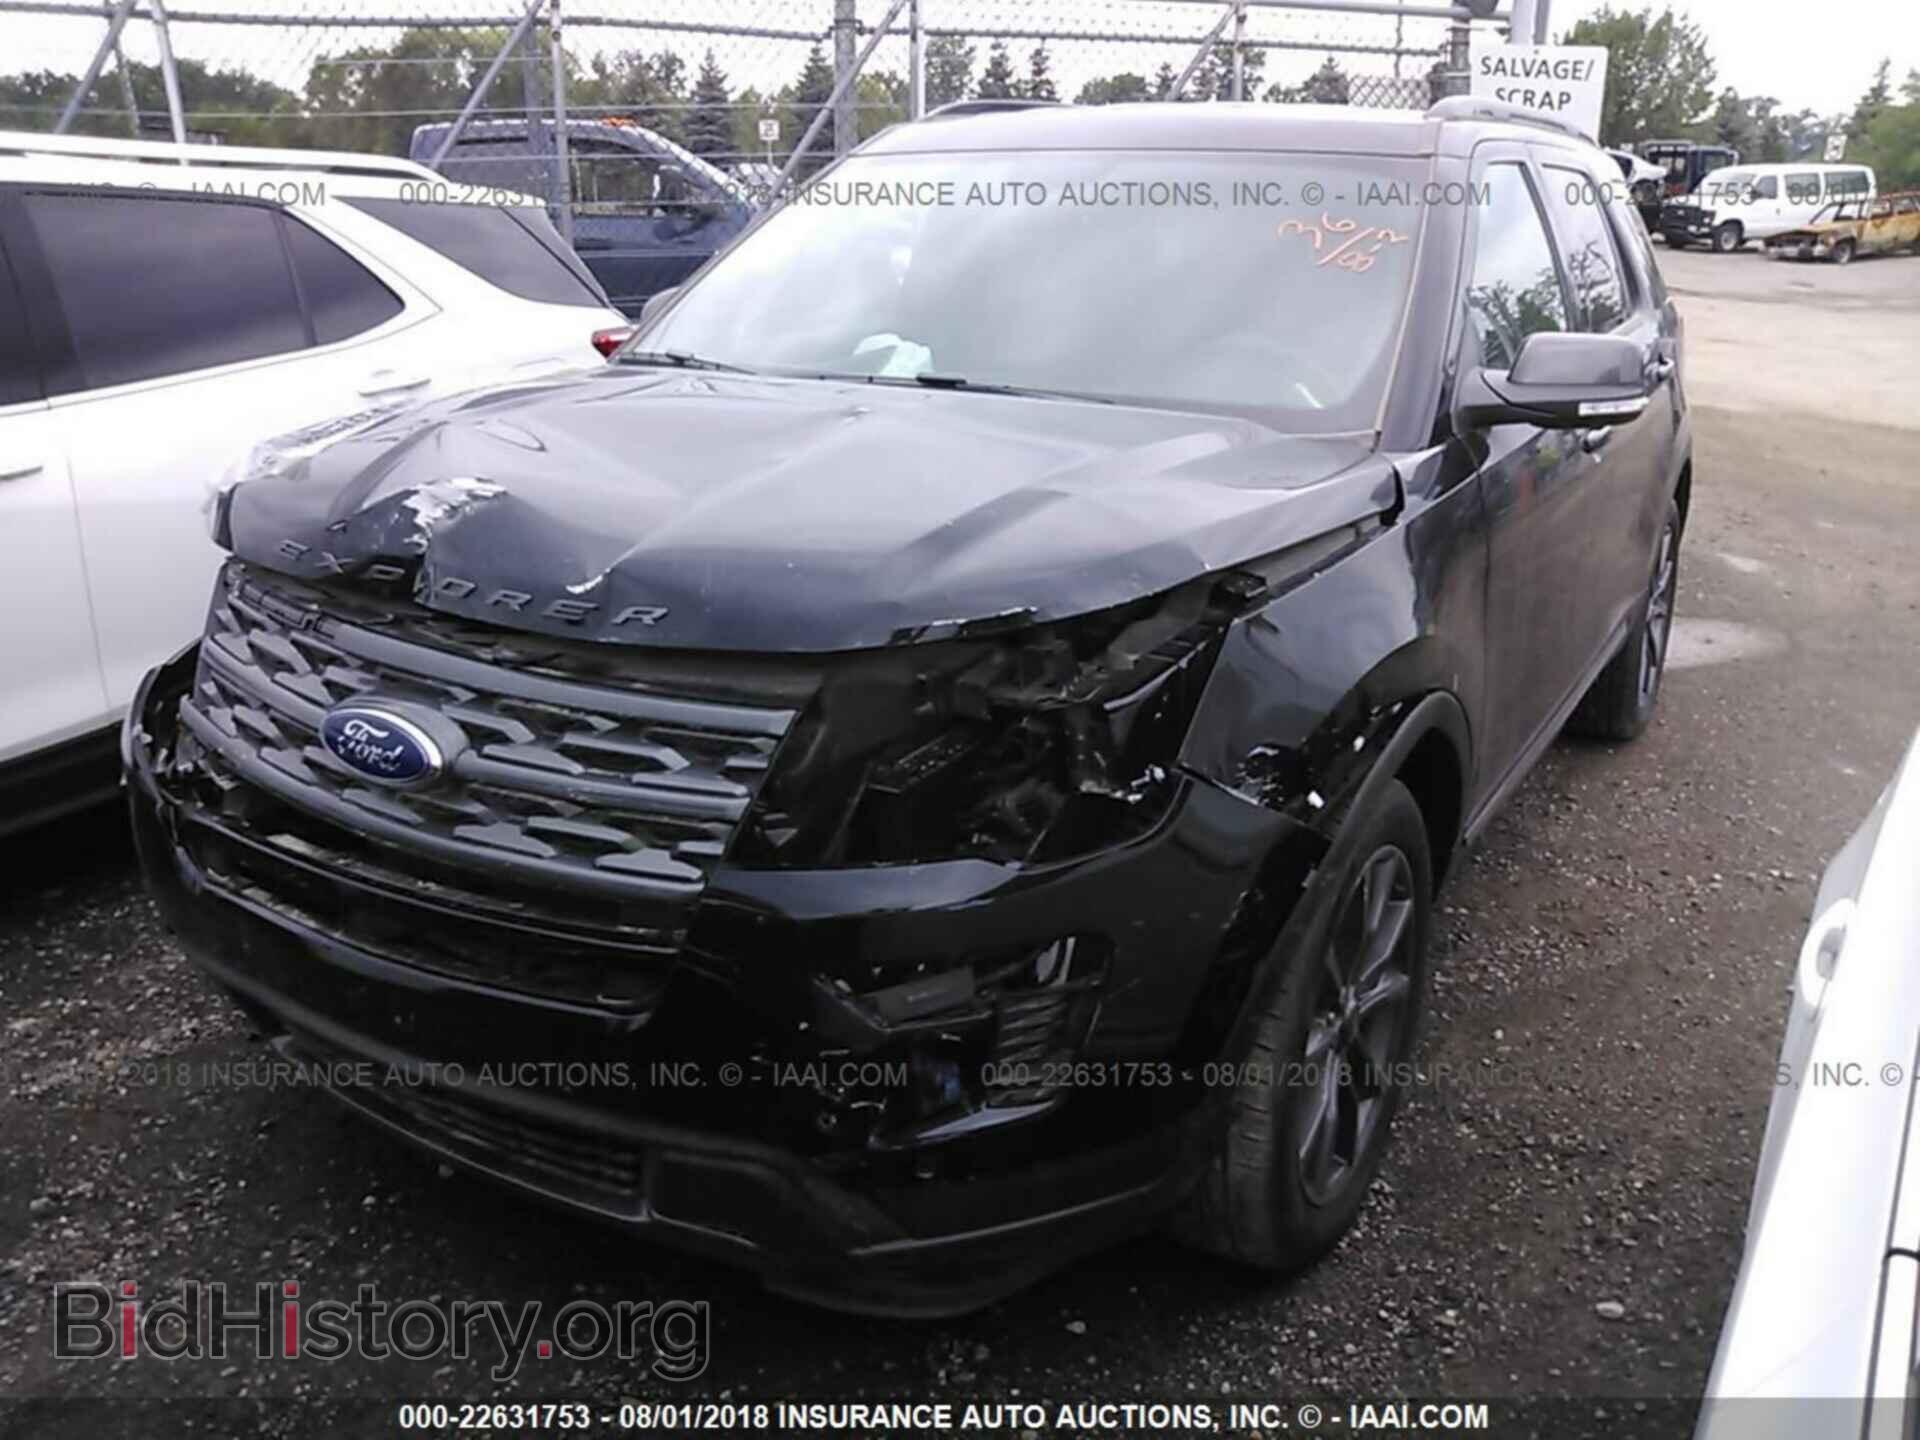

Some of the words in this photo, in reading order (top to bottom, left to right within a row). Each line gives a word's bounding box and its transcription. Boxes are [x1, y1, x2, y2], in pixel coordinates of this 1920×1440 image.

[1480, 55, 1595, 82] SALVAGE/
[1495, 87, 1572, 111] SCRAP
[337, 719, 405, 772] Ford
